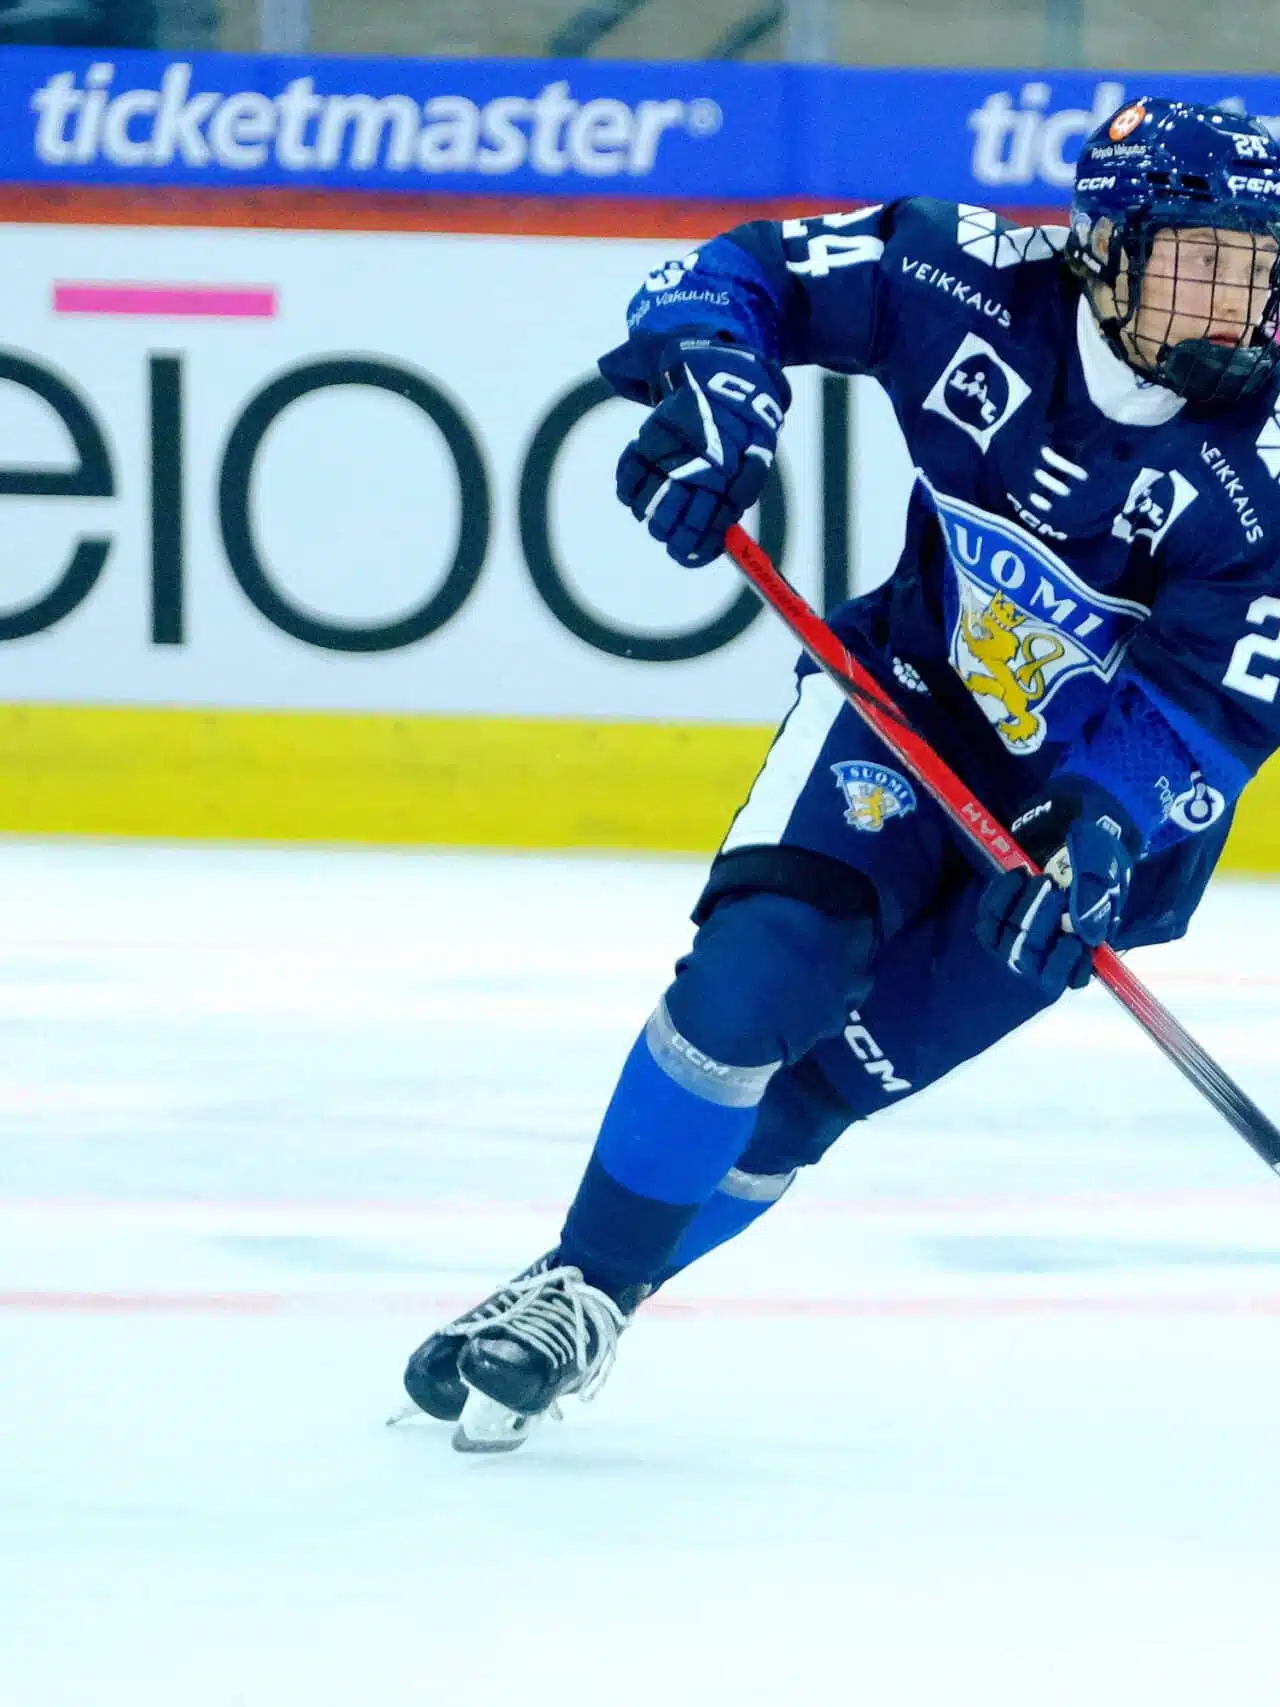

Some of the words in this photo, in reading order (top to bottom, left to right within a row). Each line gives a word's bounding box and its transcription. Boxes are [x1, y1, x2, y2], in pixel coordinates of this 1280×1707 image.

[1232, 134, 1270, 160] 24
[1077, 175, 1117, 192] CCM
[902, 256, 1012, 329] VEIKKAUS
[954, 522, 1105, 638] UOMI
[850, 766, 908, 799] SUOMI
[1010, 800, 1052, 833] CCM
[671, 1031, 730, 1076] CCM
[843, 1008, 913, 1093] CM
